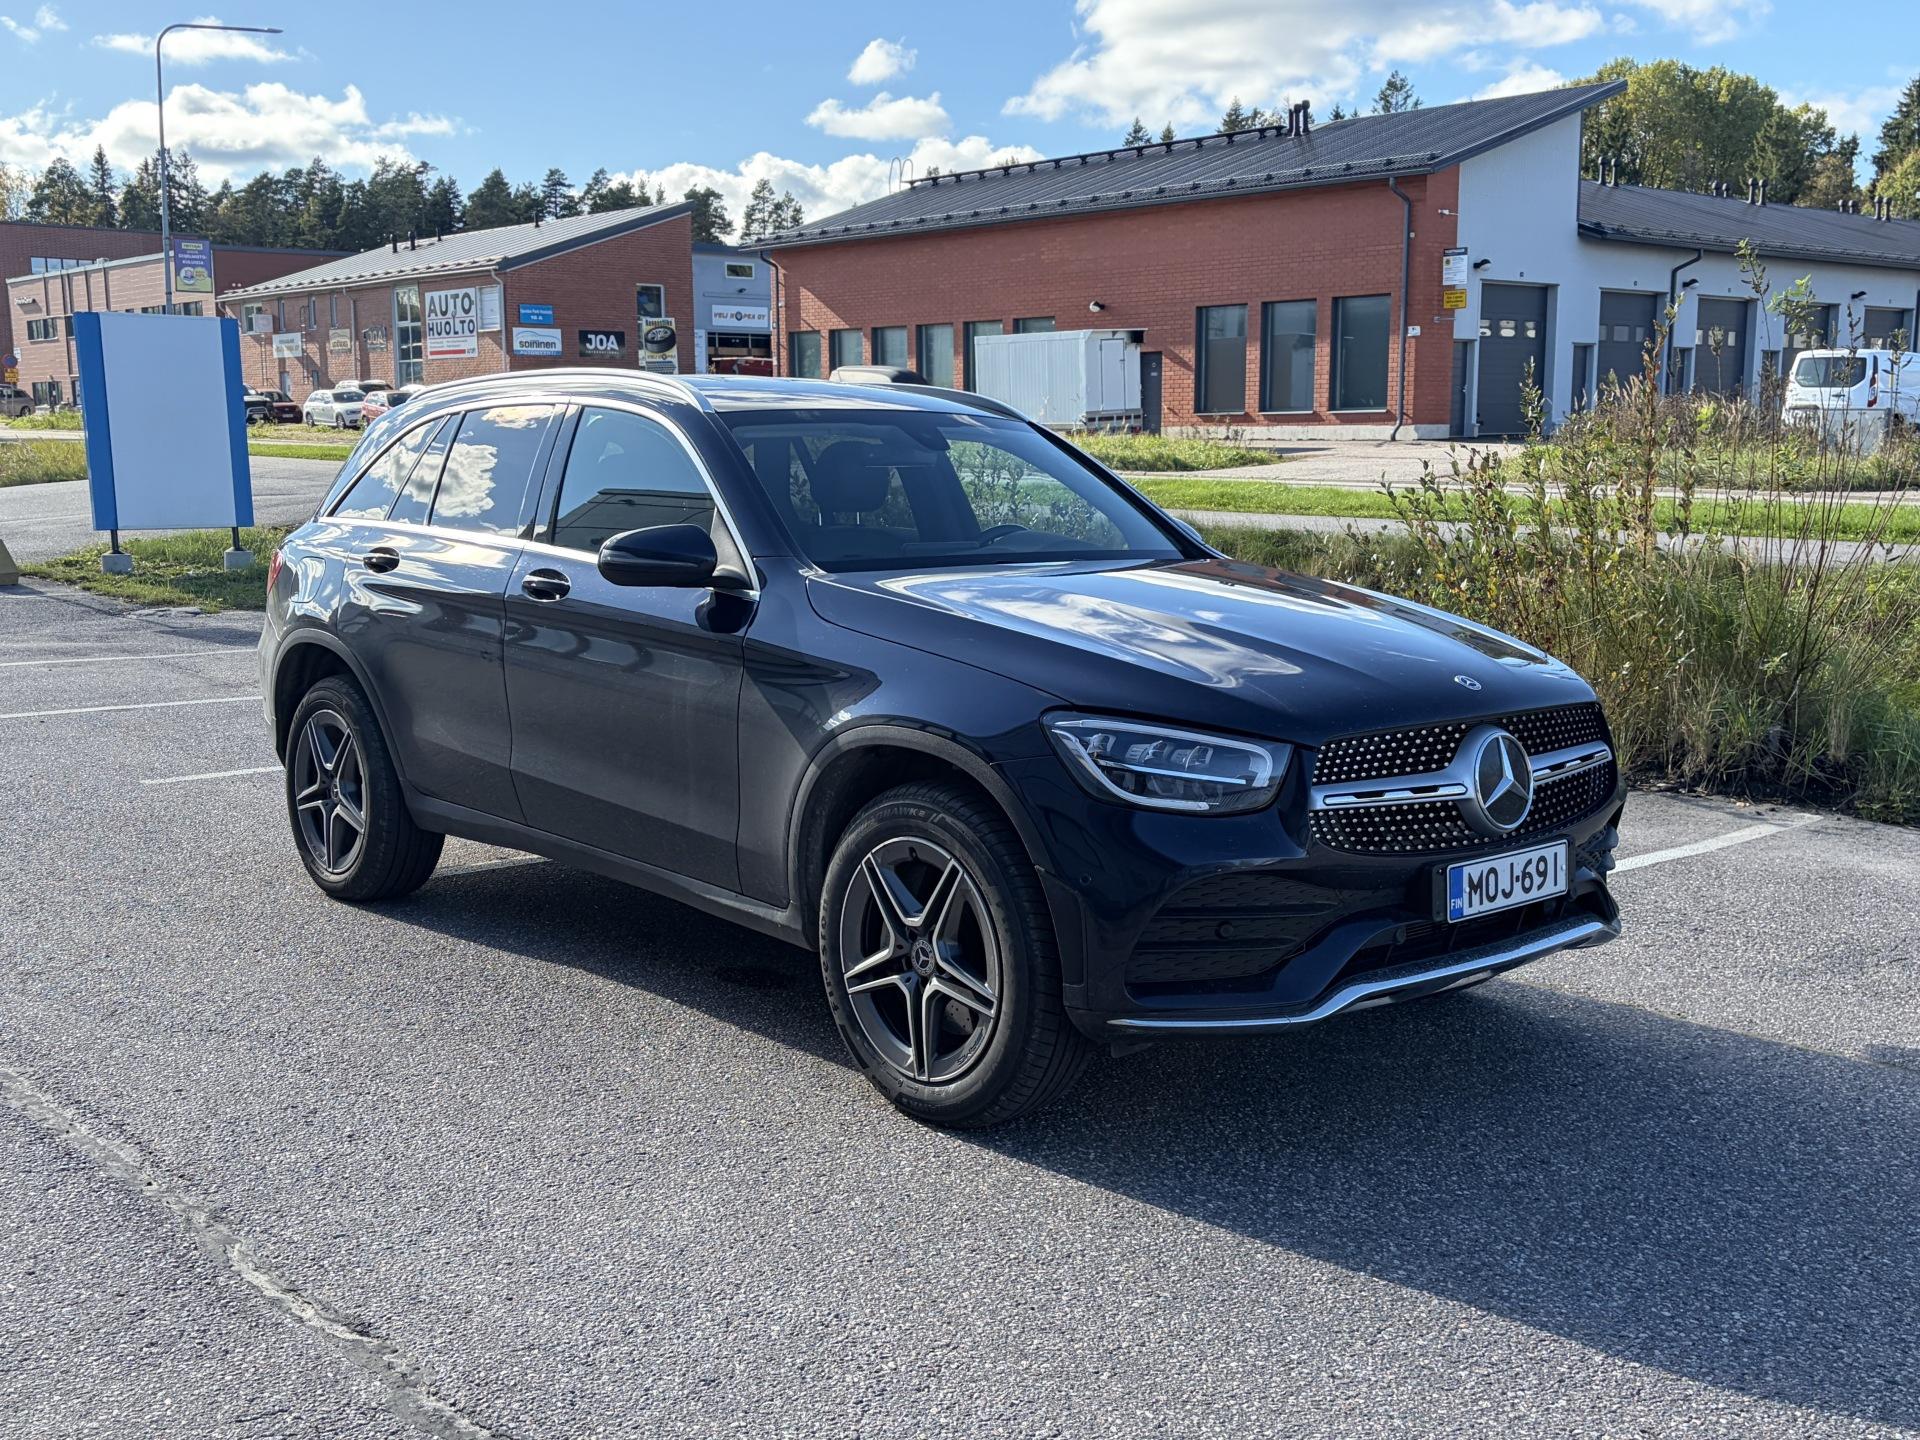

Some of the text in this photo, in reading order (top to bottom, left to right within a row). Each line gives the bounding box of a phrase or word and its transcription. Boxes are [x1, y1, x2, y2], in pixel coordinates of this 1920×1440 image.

[428, 319, 475, 337] HUOLTO
[586, 334, 619, 350] JOA
[1468, 852, 1558, 908] MOJ-691
[1451, 897, 1463, 910] FIN
